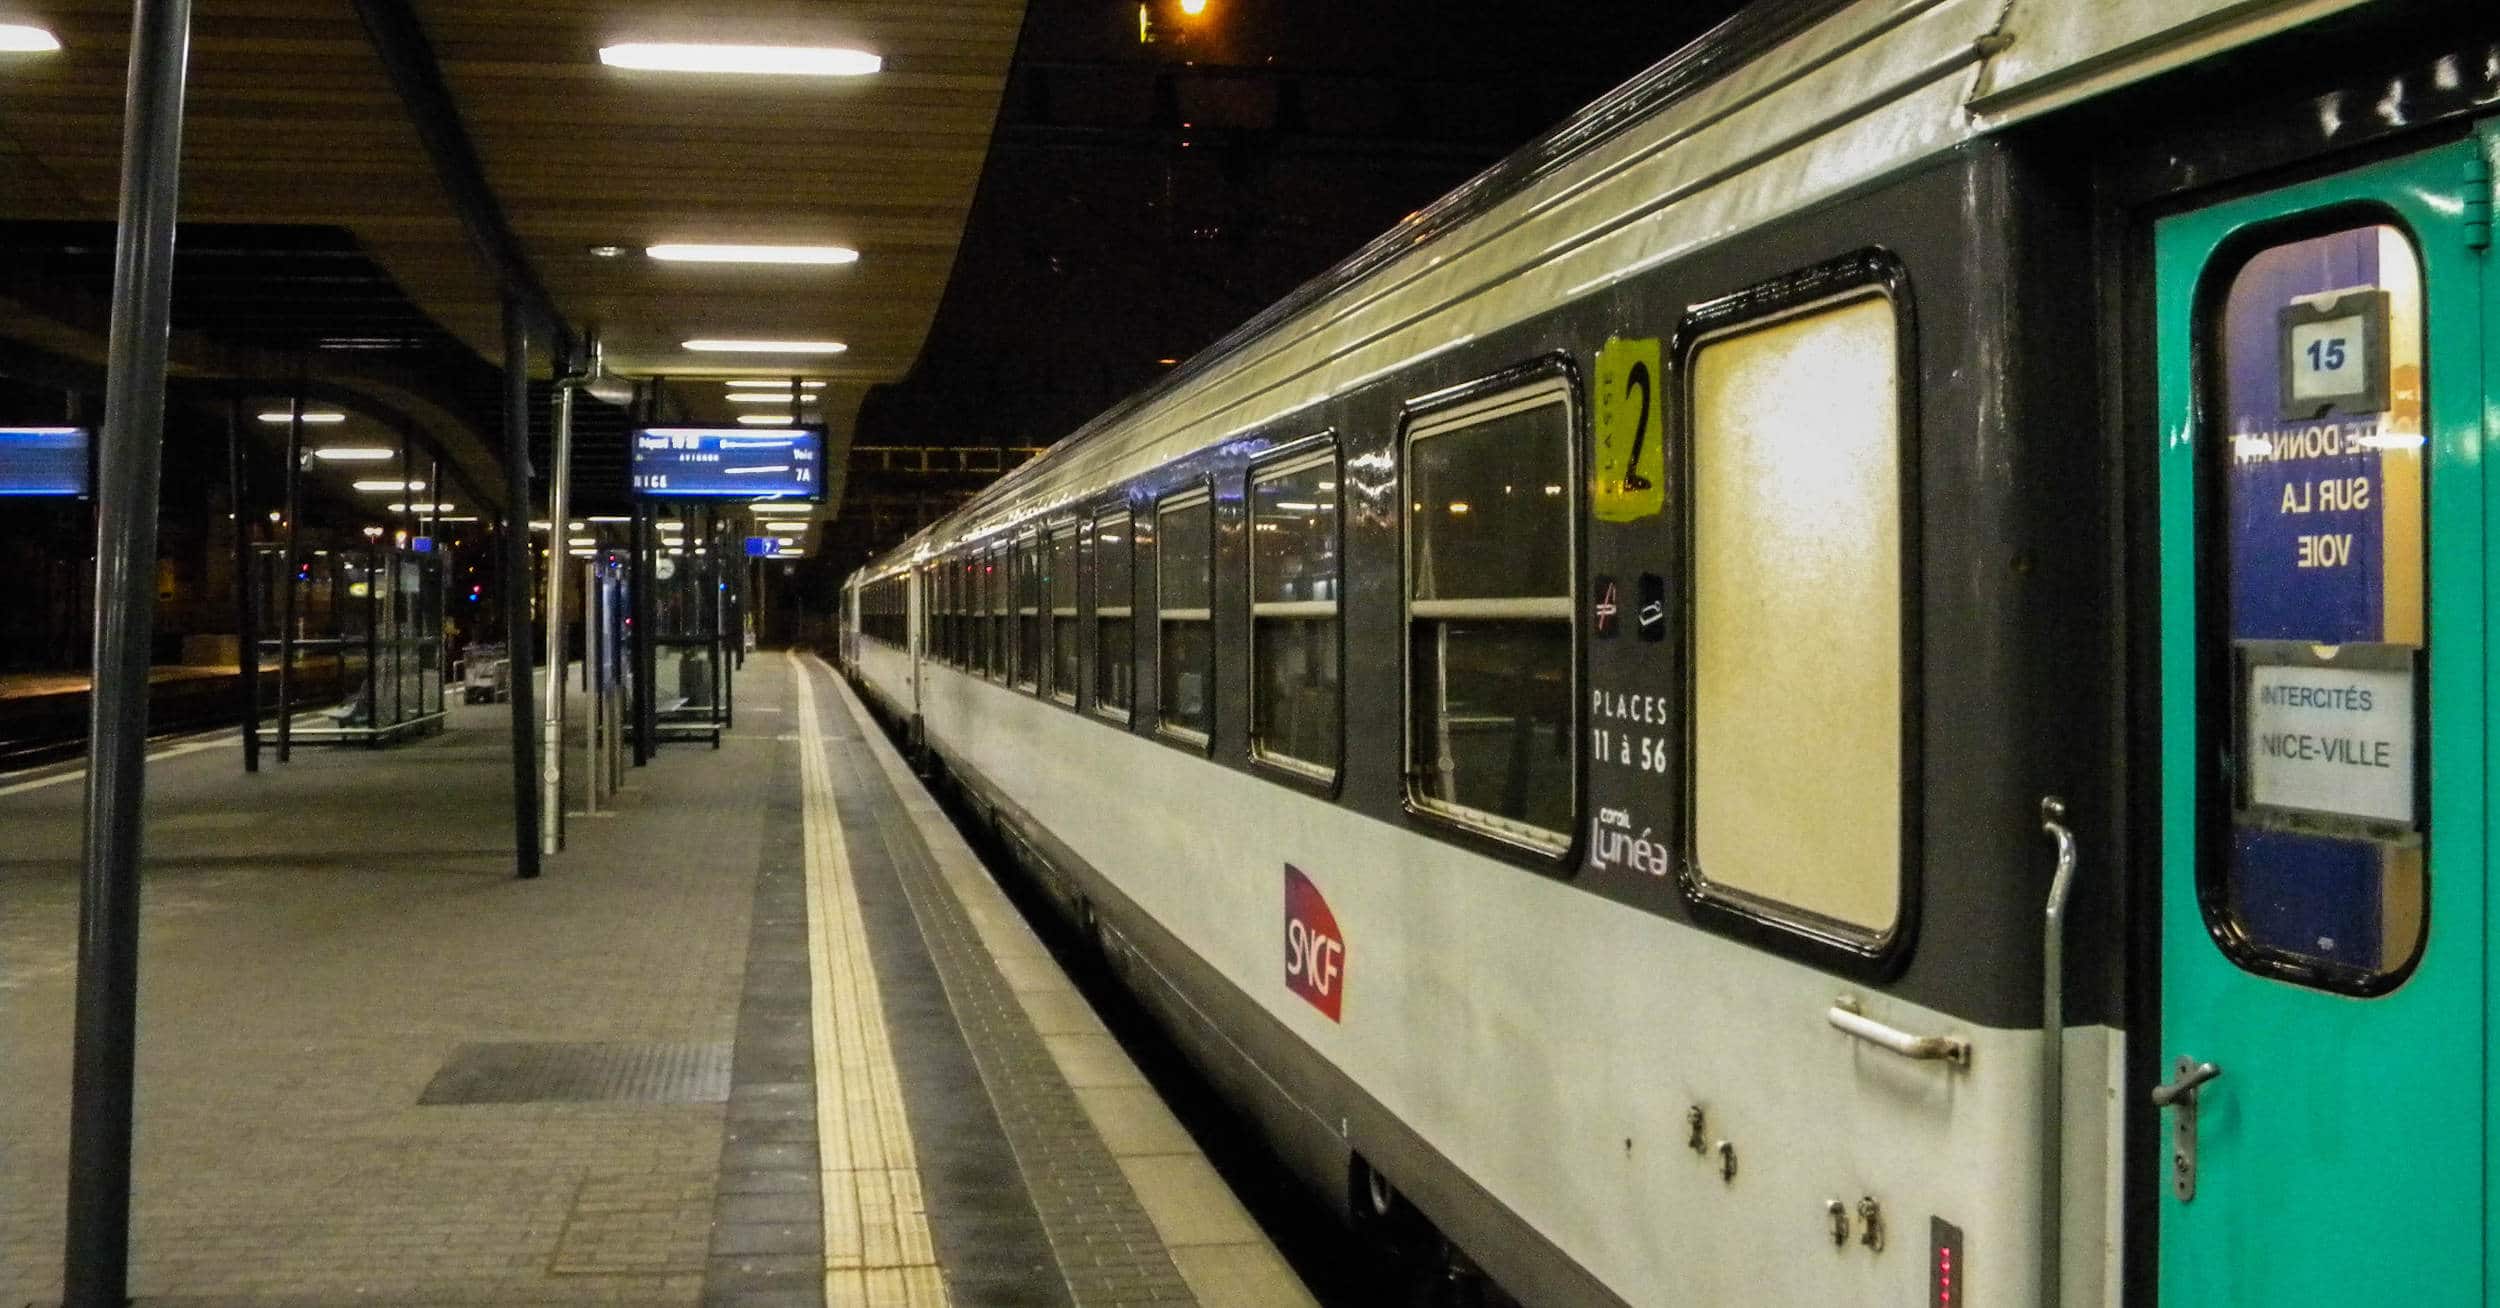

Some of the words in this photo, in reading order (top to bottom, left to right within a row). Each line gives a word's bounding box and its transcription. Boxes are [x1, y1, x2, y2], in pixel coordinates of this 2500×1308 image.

[2307, 339, 2346, 371] 15
[1625, 361, 1652, 492] 2
[796, 469, 810, 482] 7A
[1593, 690, 1667, 725] PLACES
[2261, 685, 2373, 711] INTERCITÉS
[1594, 729, 1609, 762] 11
[1620, 733, 1631, 765] à
[1641, 737, 1666, 773] 56
[2261, 733, 2390, 768] NICE-VILLE
[1591, 817, 1668, 876] Lunéa
[1287, 918, 1342, 996] SNCF
